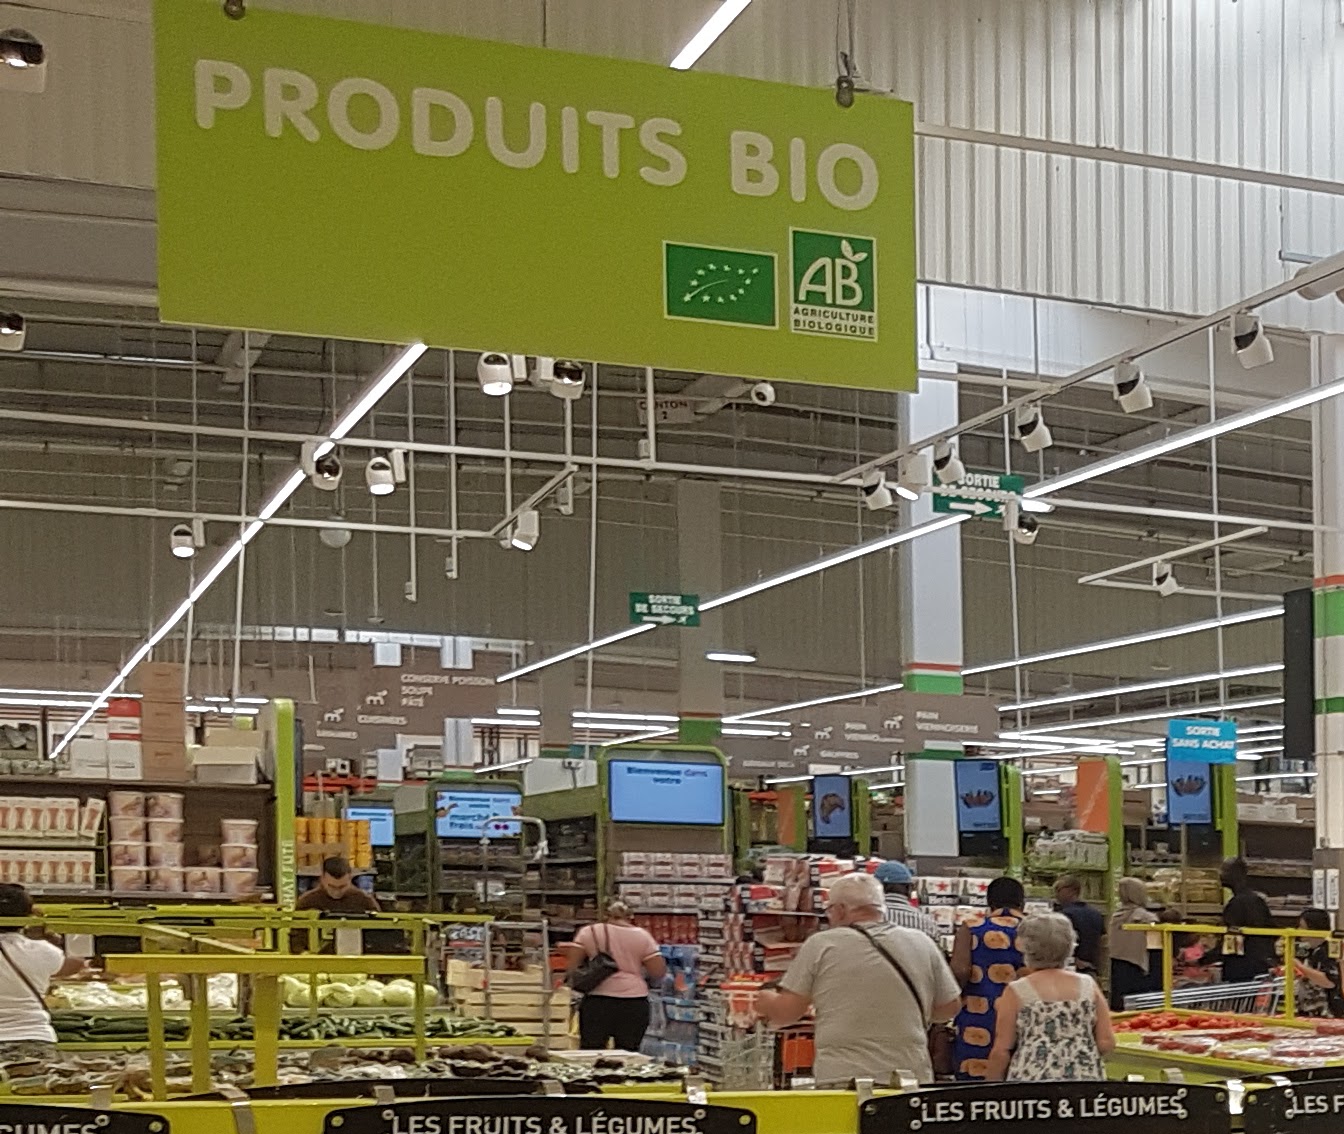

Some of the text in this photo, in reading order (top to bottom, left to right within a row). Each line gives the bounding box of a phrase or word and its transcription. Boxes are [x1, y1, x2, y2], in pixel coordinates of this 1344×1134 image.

[194, 58, 880, 211] PRODUITS BIO
[799, 257, 863, 306] AB
[794, 306, 874, 324] AGRICULTURE
[794, 319, 875, 336] BIOLOGIQUE
[640, 401, 688, 410] CNTON
[1186, 726, 1220, 737] SORTIE
[922, 1093, 1182, 1122] LES FRUITS & LÉGUMES
[1293, 1095, 1328, 1114] LES
